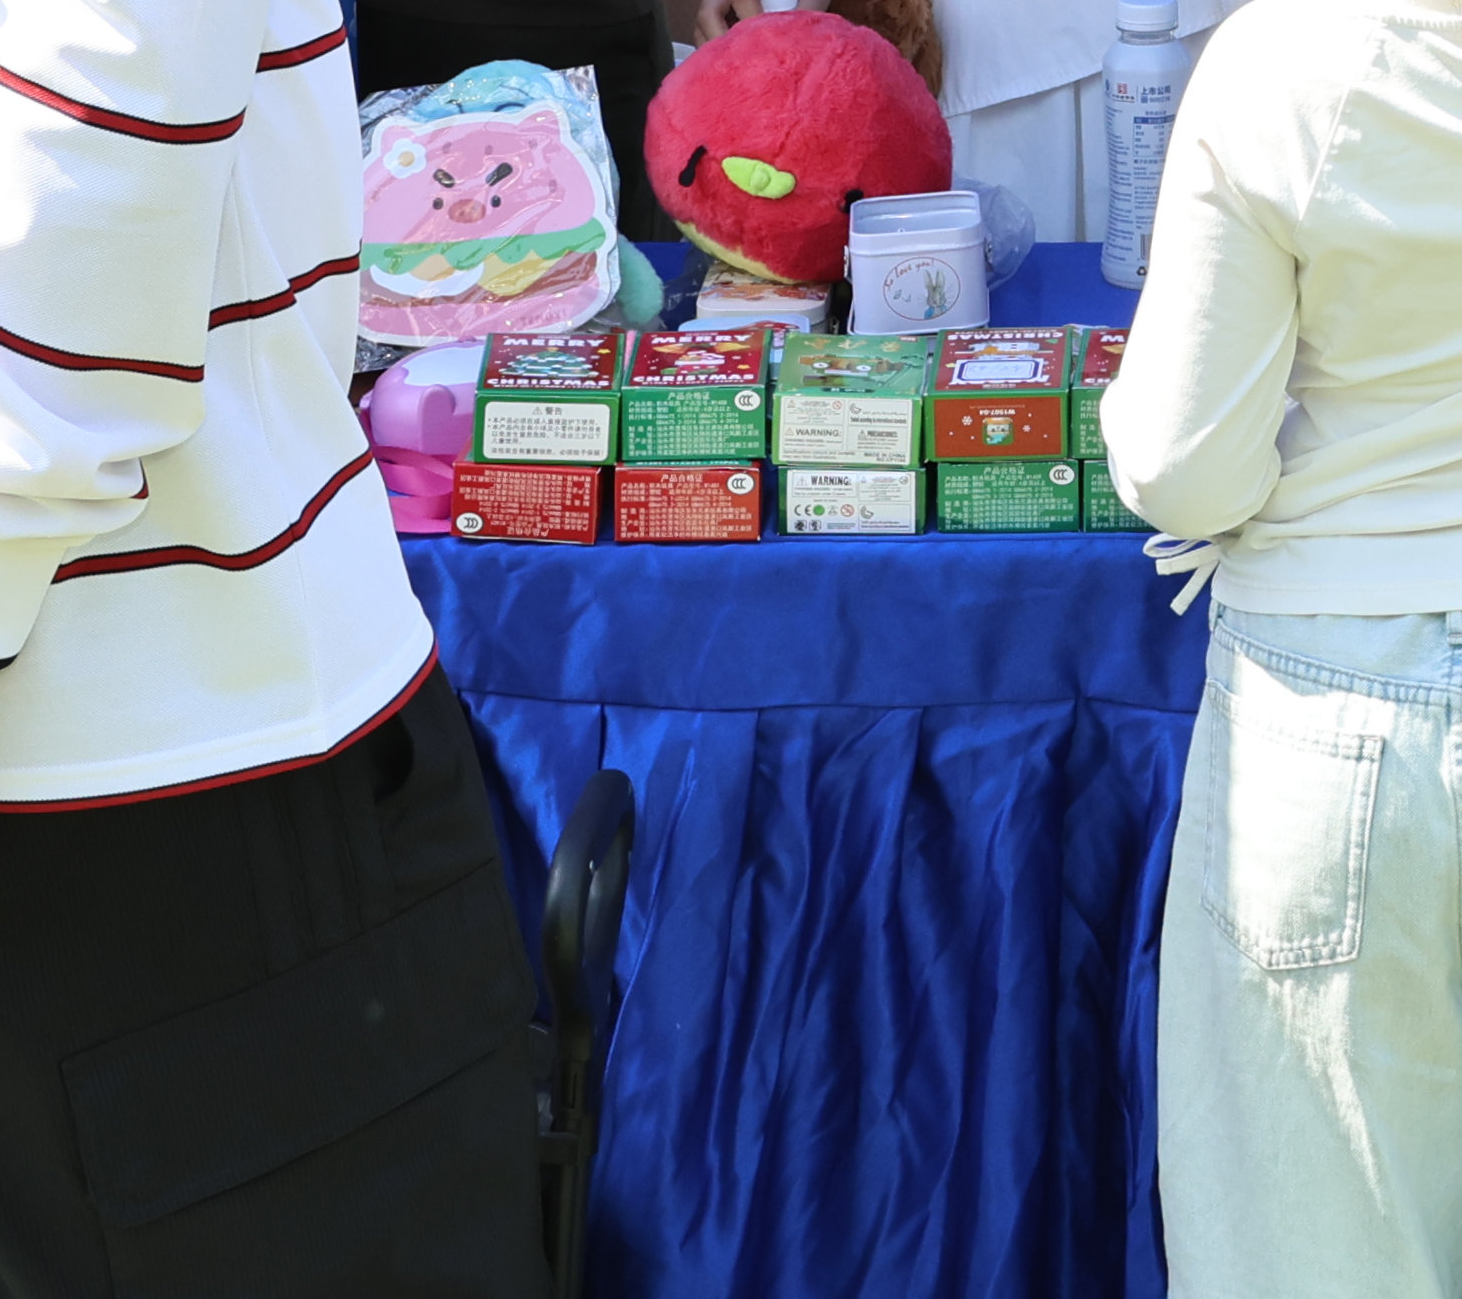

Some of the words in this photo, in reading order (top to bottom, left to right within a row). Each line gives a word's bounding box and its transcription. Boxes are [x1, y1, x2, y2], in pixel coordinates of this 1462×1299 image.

[651, 334, 752, 344] MERRY
[947, 332, 1063, 340] CHRISTMAS
[503, 339, 606, 347] MERRY
[633, 374, 754, 382] CHRISTMAS
[487, 379, 609, 387] CHRISTMAS
[796, 428, 842, 437] WARNING:
[810, 475, 852, 486] WARNING:
